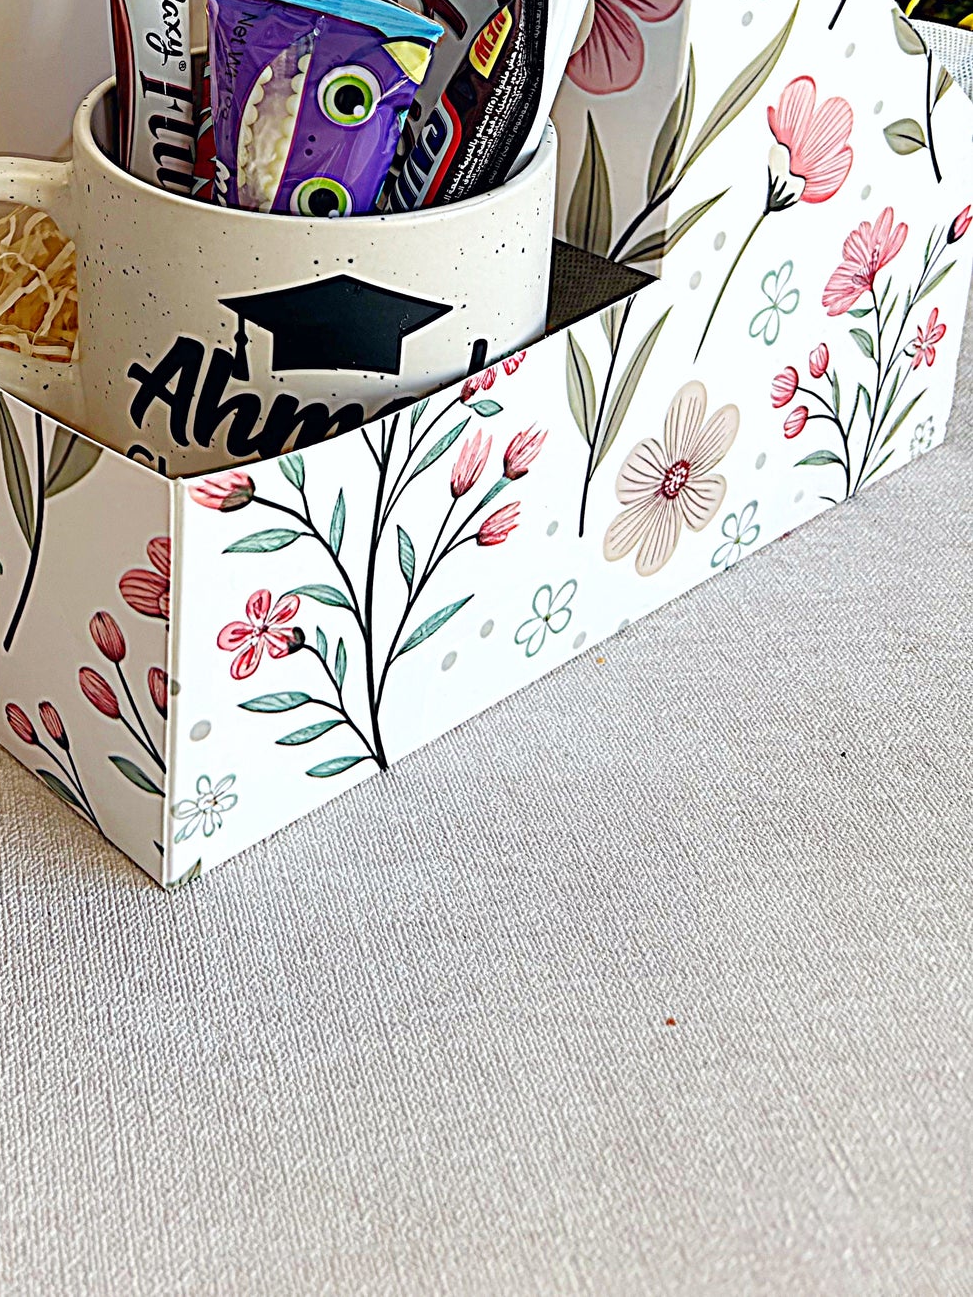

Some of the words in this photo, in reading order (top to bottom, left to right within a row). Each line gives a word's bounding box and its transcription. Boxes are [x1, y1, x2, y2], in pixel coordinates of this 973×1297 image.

[232, 12, 258, 46] Net
[474, 11, 507, 67] NEW
[127, 336, 488, 457] Ahm
